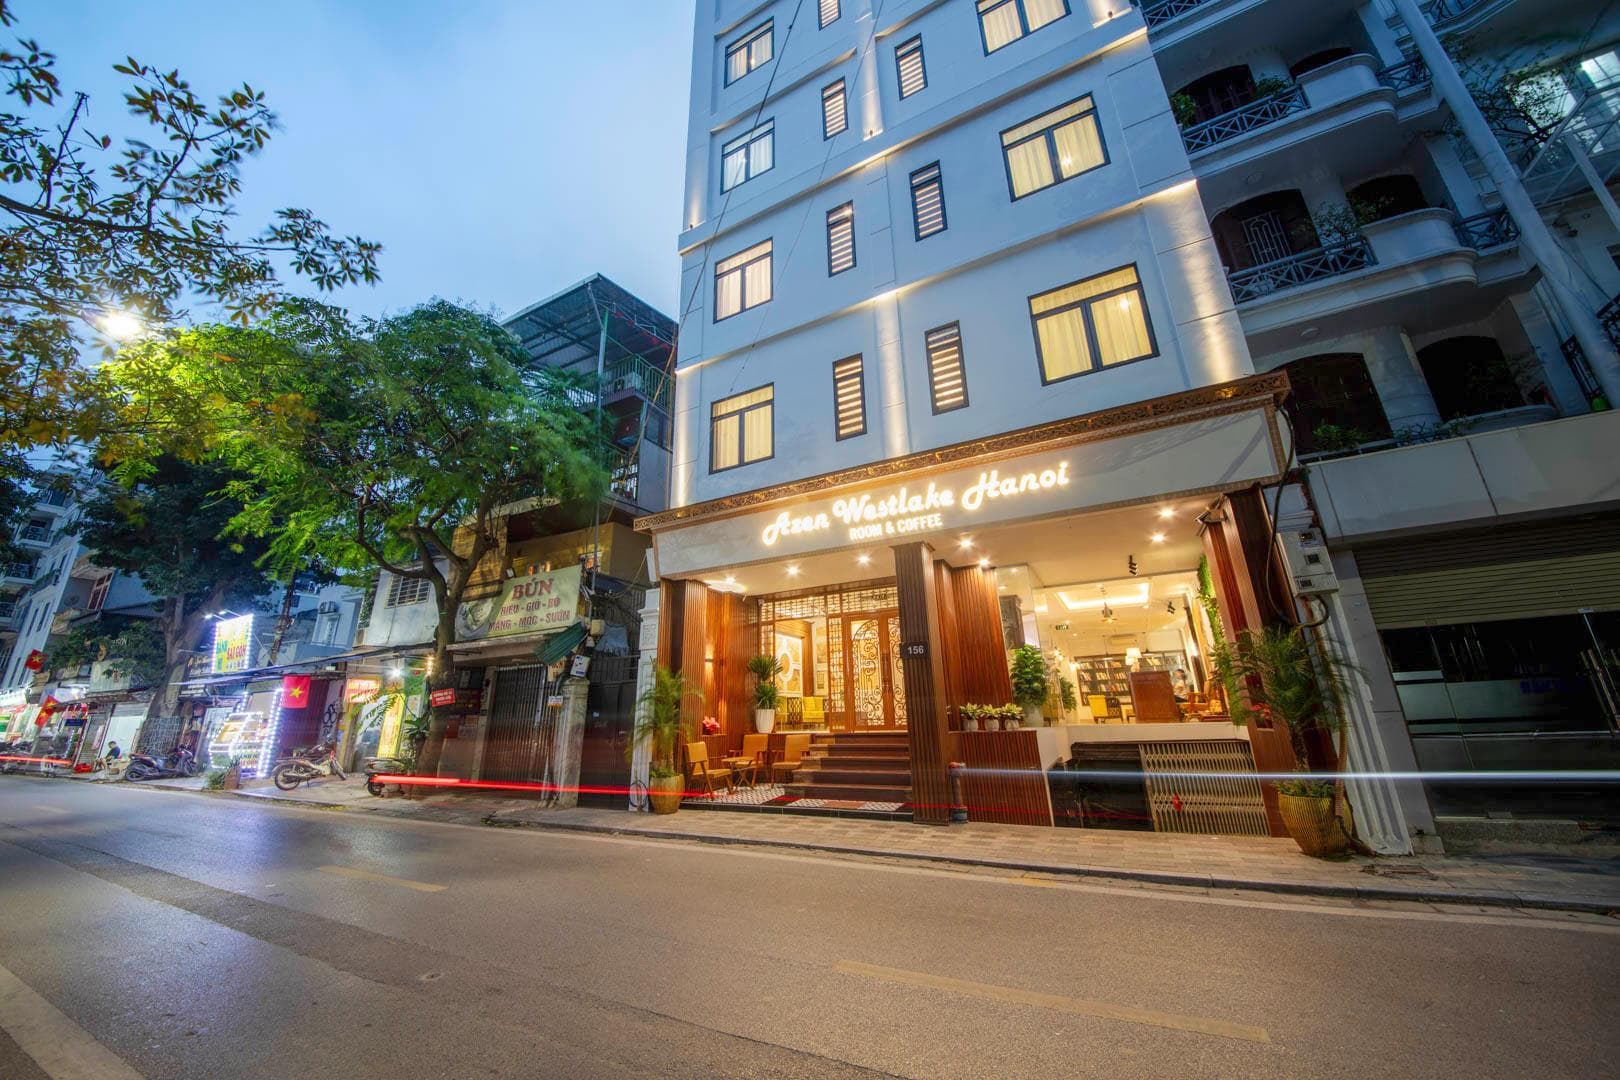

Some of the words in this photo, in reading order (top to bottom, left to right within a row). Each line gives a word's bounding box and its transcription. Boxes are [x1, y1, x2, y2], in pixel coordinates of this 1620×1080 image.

[832, 482, 955, 524] Westlake
[962, 461, 1070, 510] Hanoi
[849, 524, 883, 541] ROOM
[885, 521, 896, 535] &
[896, 513, 943, 533] COFFEE
[512, 577, 554, 600] BÚN
[907, 644, 925, 655] 156
